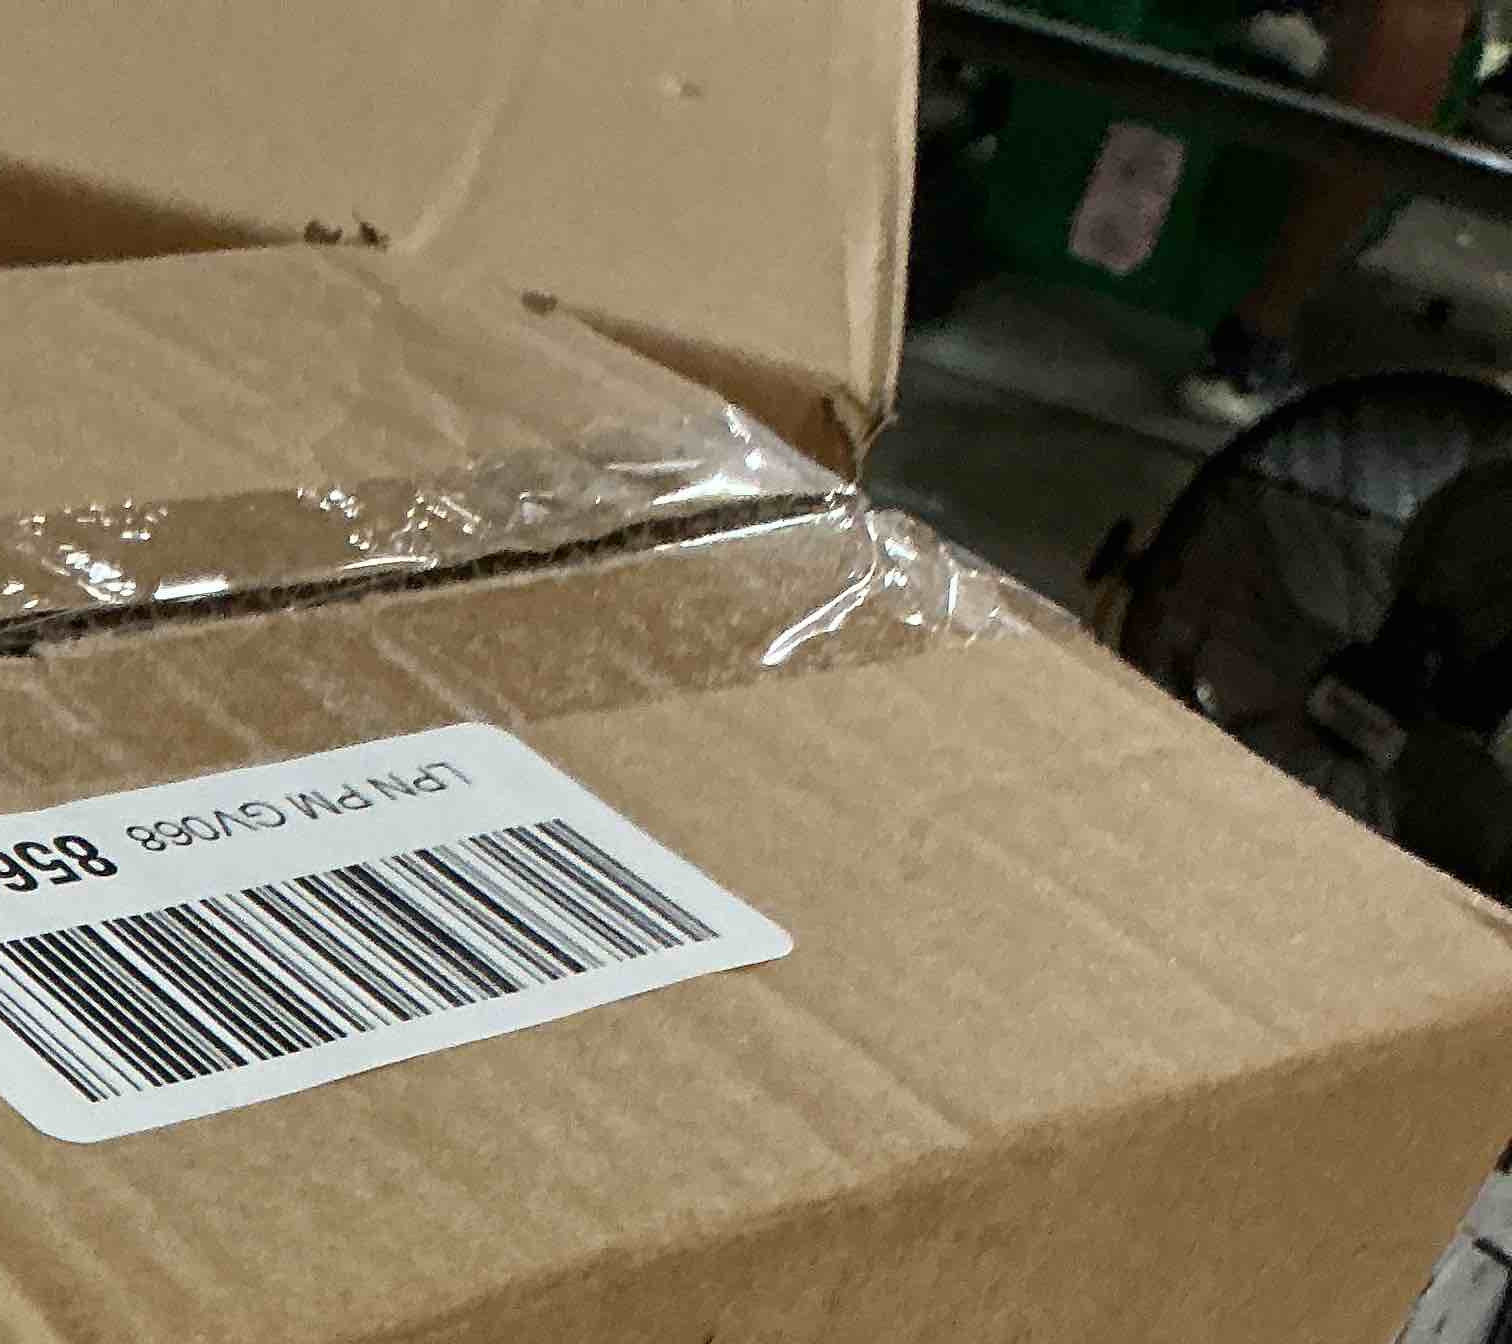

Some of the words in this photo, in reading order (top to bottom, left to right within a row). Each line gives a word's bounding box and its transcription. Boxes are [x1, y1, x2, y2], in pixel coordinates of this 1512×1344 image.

[367, 760, 473, 802] LPN
[286, 783, 373, 822] PM
[125, 800, 286, 853] GV068
